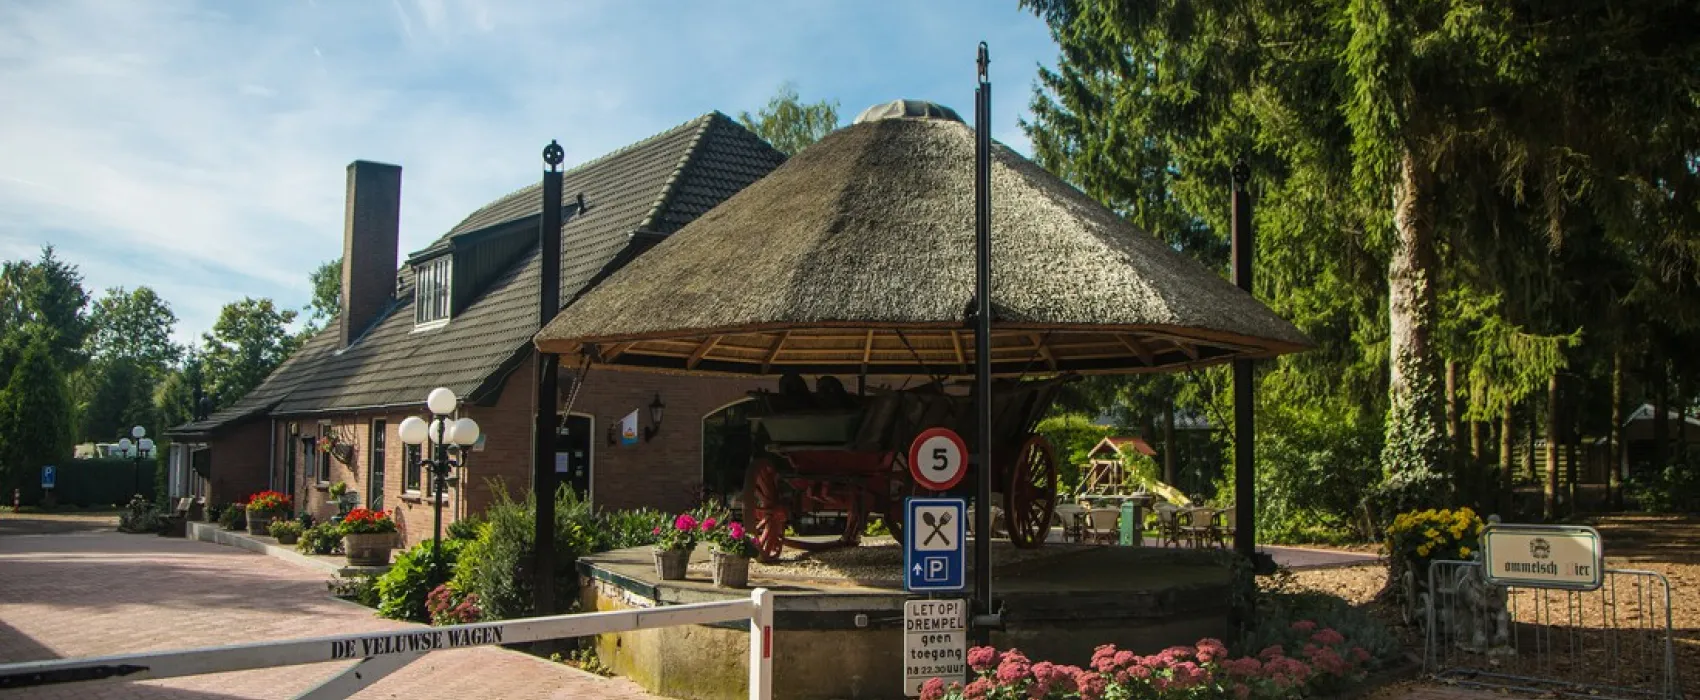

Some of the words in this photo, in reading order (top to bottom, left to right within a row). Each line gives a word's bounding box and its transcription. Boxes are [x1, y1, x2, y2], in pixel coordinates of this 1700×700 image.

[932, 448, 948, 471] 5
[929, 560, 944, 578] P
[913, 604, 934, 616] LET
[938, 603, 958, 615] OP!
[907, 617, 964, 630] DREMPEL
[331, 639, 355, 659] DE
[361, 631, 443, 657] VELUWSE
[448, 626, 503, 648] WAGEN
[921, 634, 951, 647] geen
[911, 648, 962, 661] toegang
[907, 666, 919, 675] na
